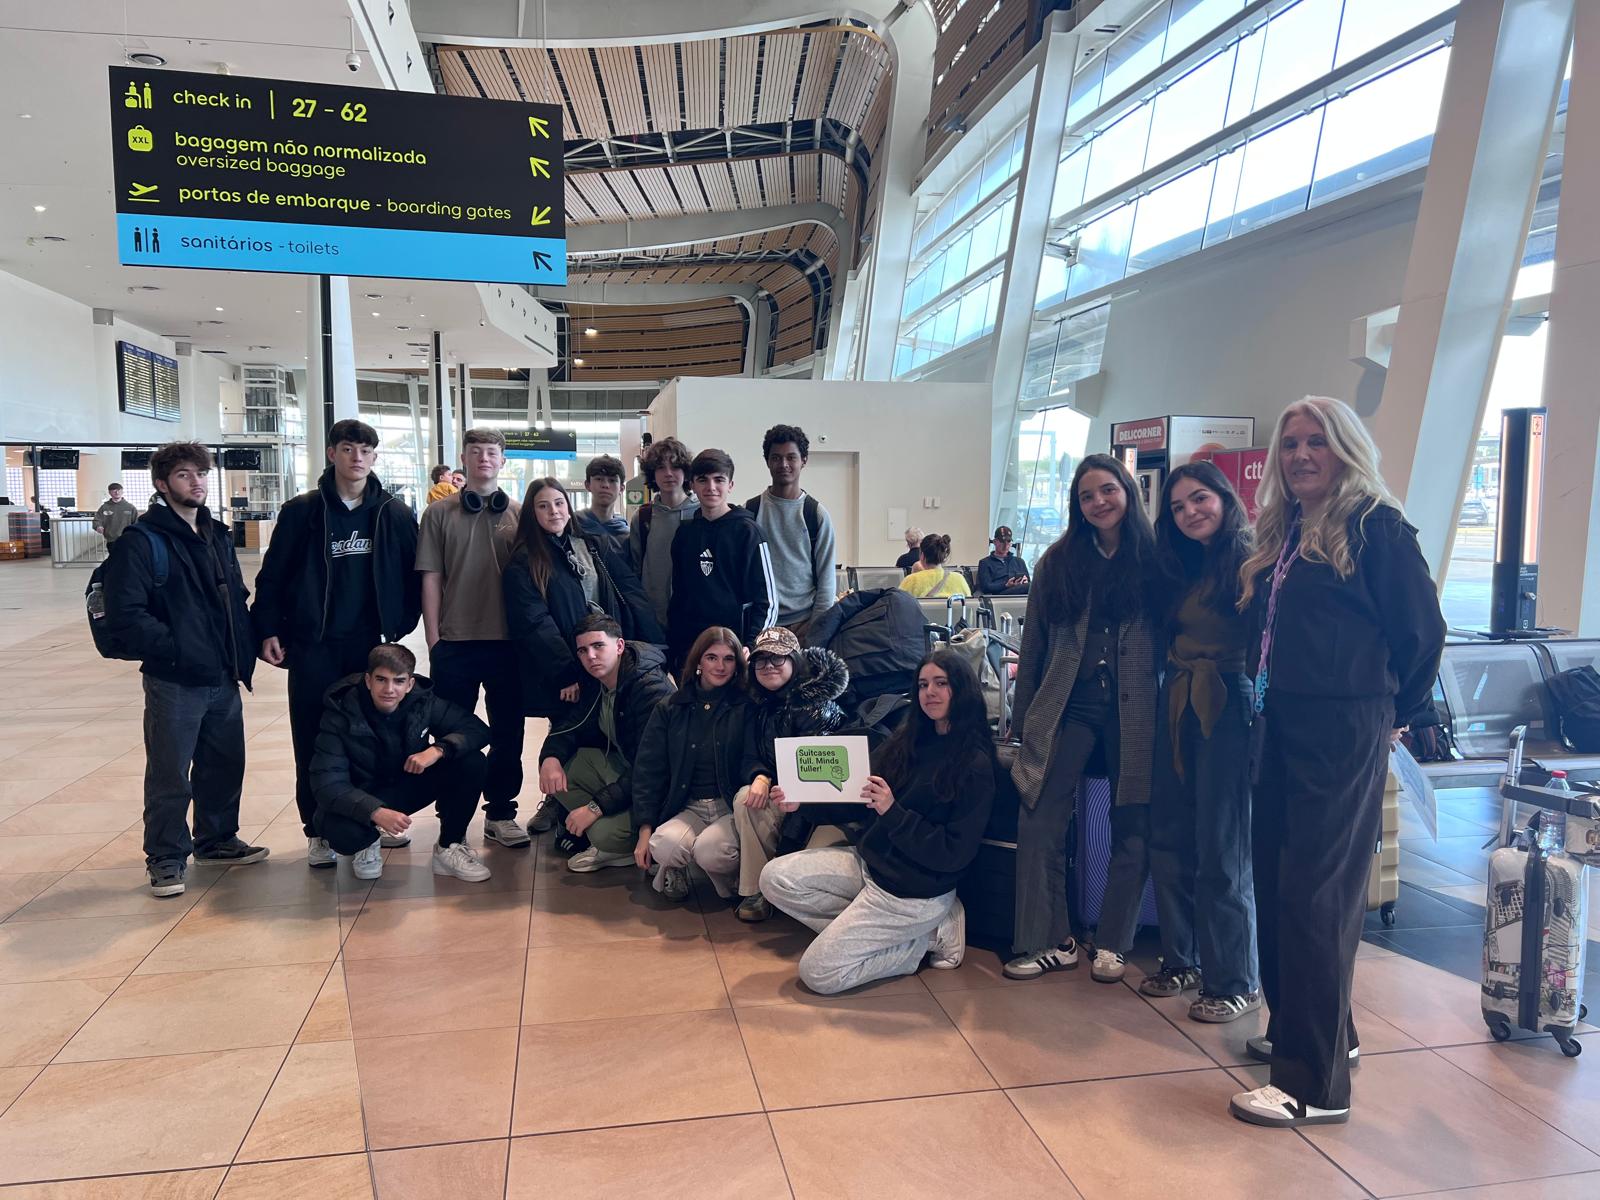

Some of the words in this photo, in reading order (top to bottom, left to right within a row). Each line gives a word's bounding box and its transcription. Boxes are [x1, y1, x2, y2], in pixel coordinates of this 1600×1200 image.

[173, 90, 230, 108] check
[235, 94, 252, 110] in
[292, 97, 317, 119] 27
[340, 102, 368, 123] 62
[175, 132, 268, 154] bagagem
[273, 140, 309, 155] não
[313, 146, 427, 165] normalizada
[176, 155, 262, 171] oversized
[266, 159, 346, 179] baggage
[179, 187, 242, 205] portas
[246, 190, 270, 205] de
[275, 193, 371, 212] embarque
[387, 199, 463, 219] boarding
[466, 206, 512, 222] gates
[180, 235, 274, 252] sanitários
[287, 240, 340, 256] toilets
[1119, 425, 1162, 442] DELICORNER
[1244, 460, 1262, 480] ctt
[330, 530, 372, 553] ordan
[798, 748, 836, 757] Suitcases
[799, 757, 814, 765] full.
[816, 757, 840, 765] Minds
[800, 764, 822, 773] fuller!
